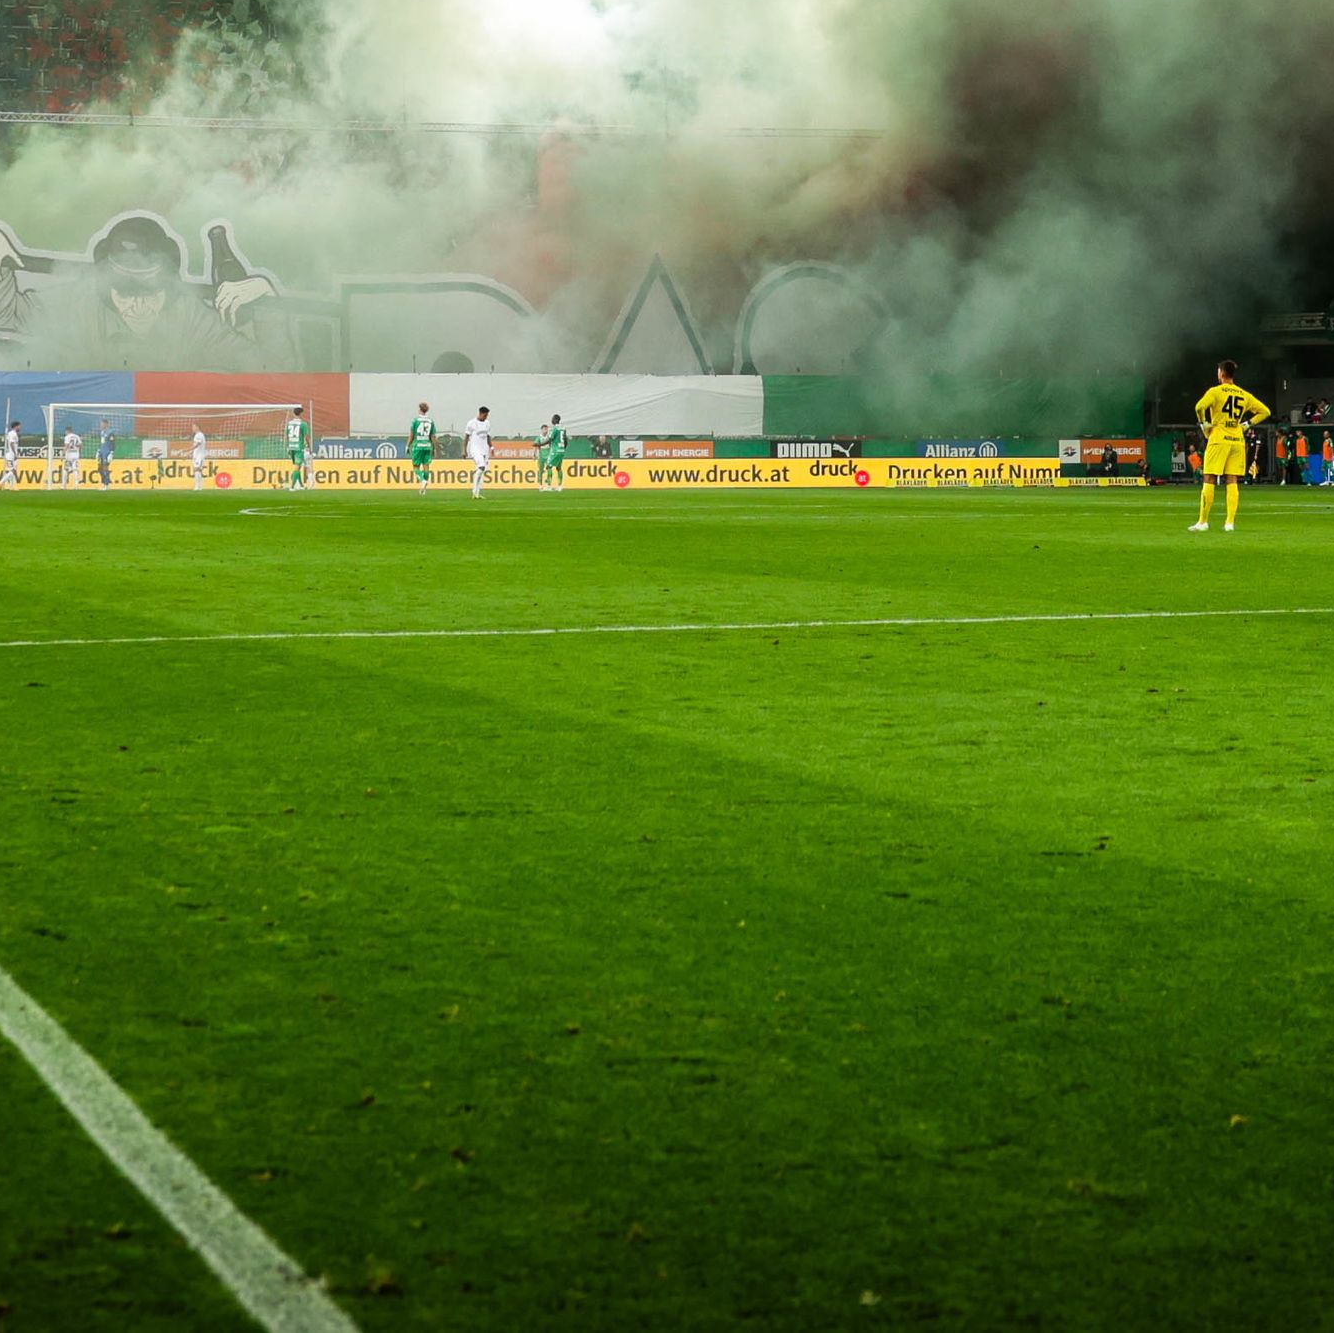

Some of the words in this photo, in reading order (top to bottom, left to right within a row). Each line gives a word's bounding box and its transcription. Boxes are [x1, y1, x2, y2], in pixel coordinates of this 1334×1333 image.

[1222, 395, 1244, 420] 45
[288, 426, 302, 438] 34
[417, 422, 432, 436] 43
[317, 445, 372, 458] Allianz
[672, 448, 708, 456] ENERGIE
[926, 444, 976, 458] Allianz
[347, 466, 382, 484] auf
[568, 462, 617, 477] druck
[649, 465, 790, 482] www.druck.at
[810, 460, 857, 476] druck
